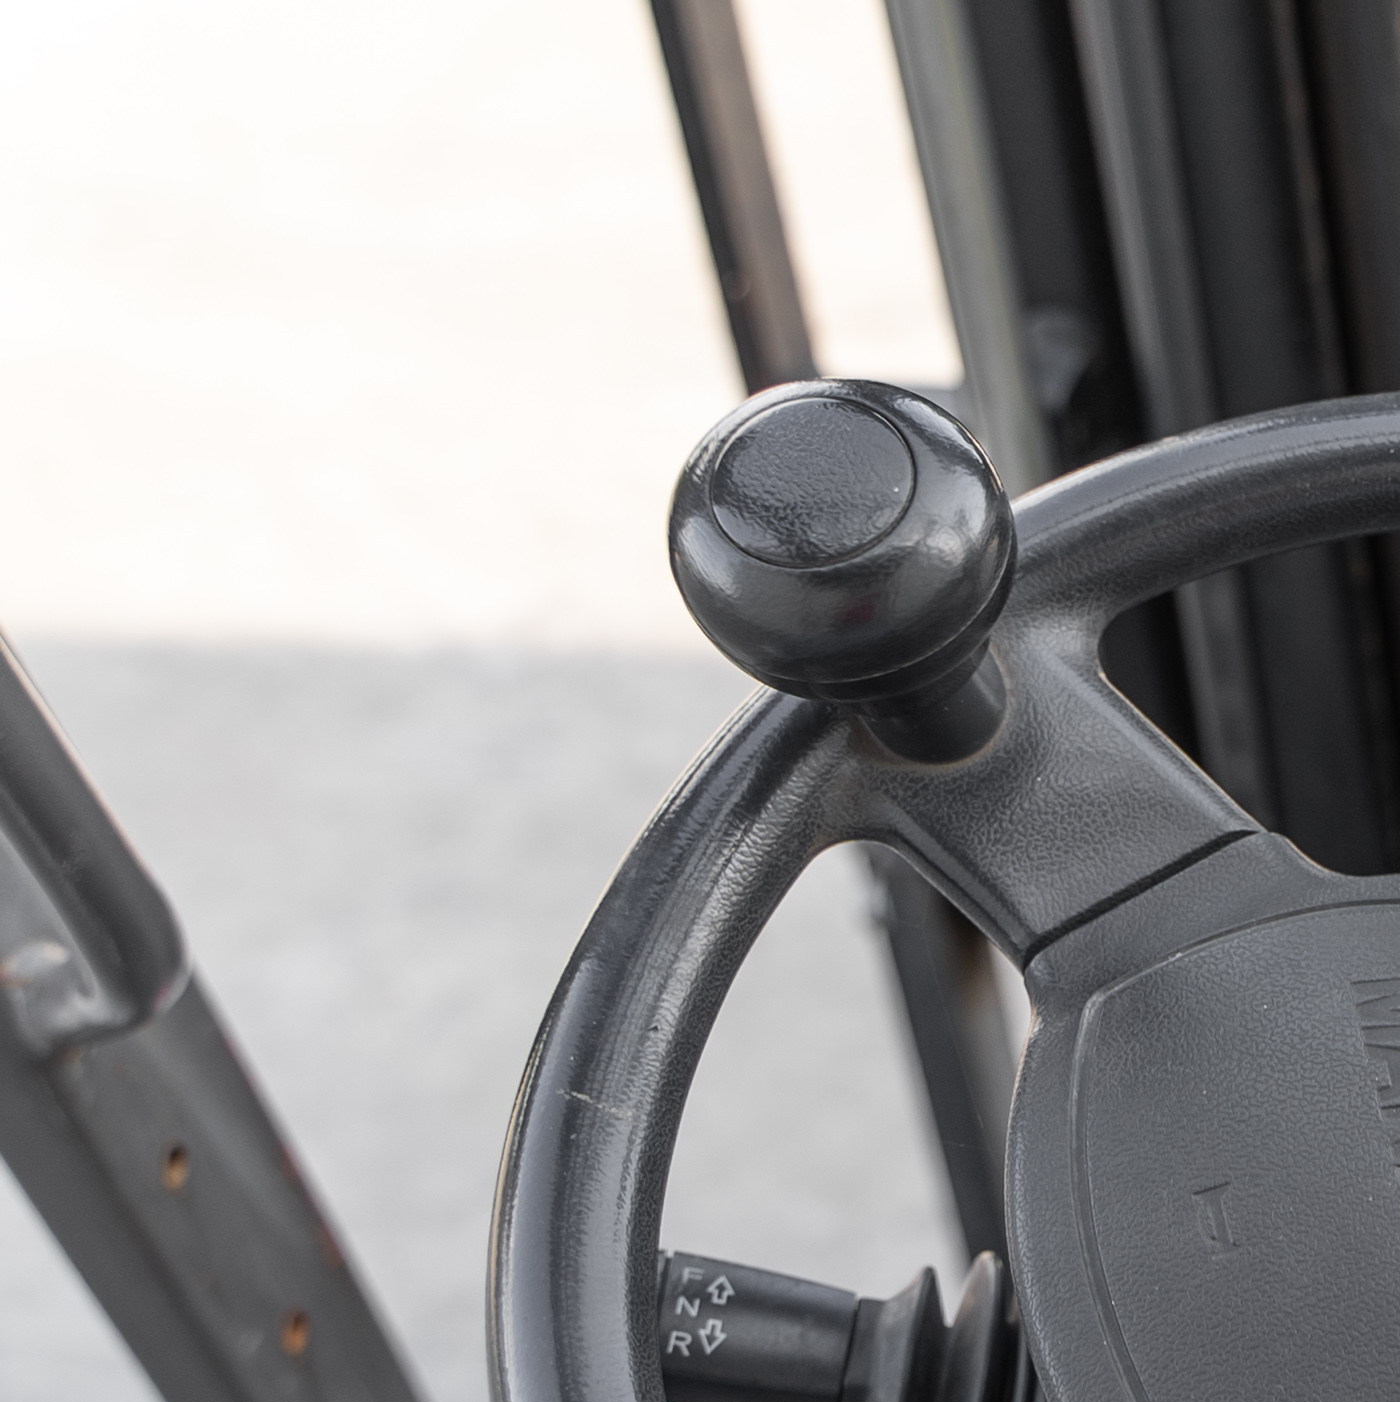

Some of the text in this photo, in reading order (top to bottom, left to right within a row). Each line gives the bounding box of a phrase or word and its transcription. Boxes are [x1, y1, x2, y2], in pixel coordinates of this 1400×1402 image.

[683, 1267, 705, 1284] F
[675, 1295, 700, 1317] N
[666, 1331, 691, 1356] R
